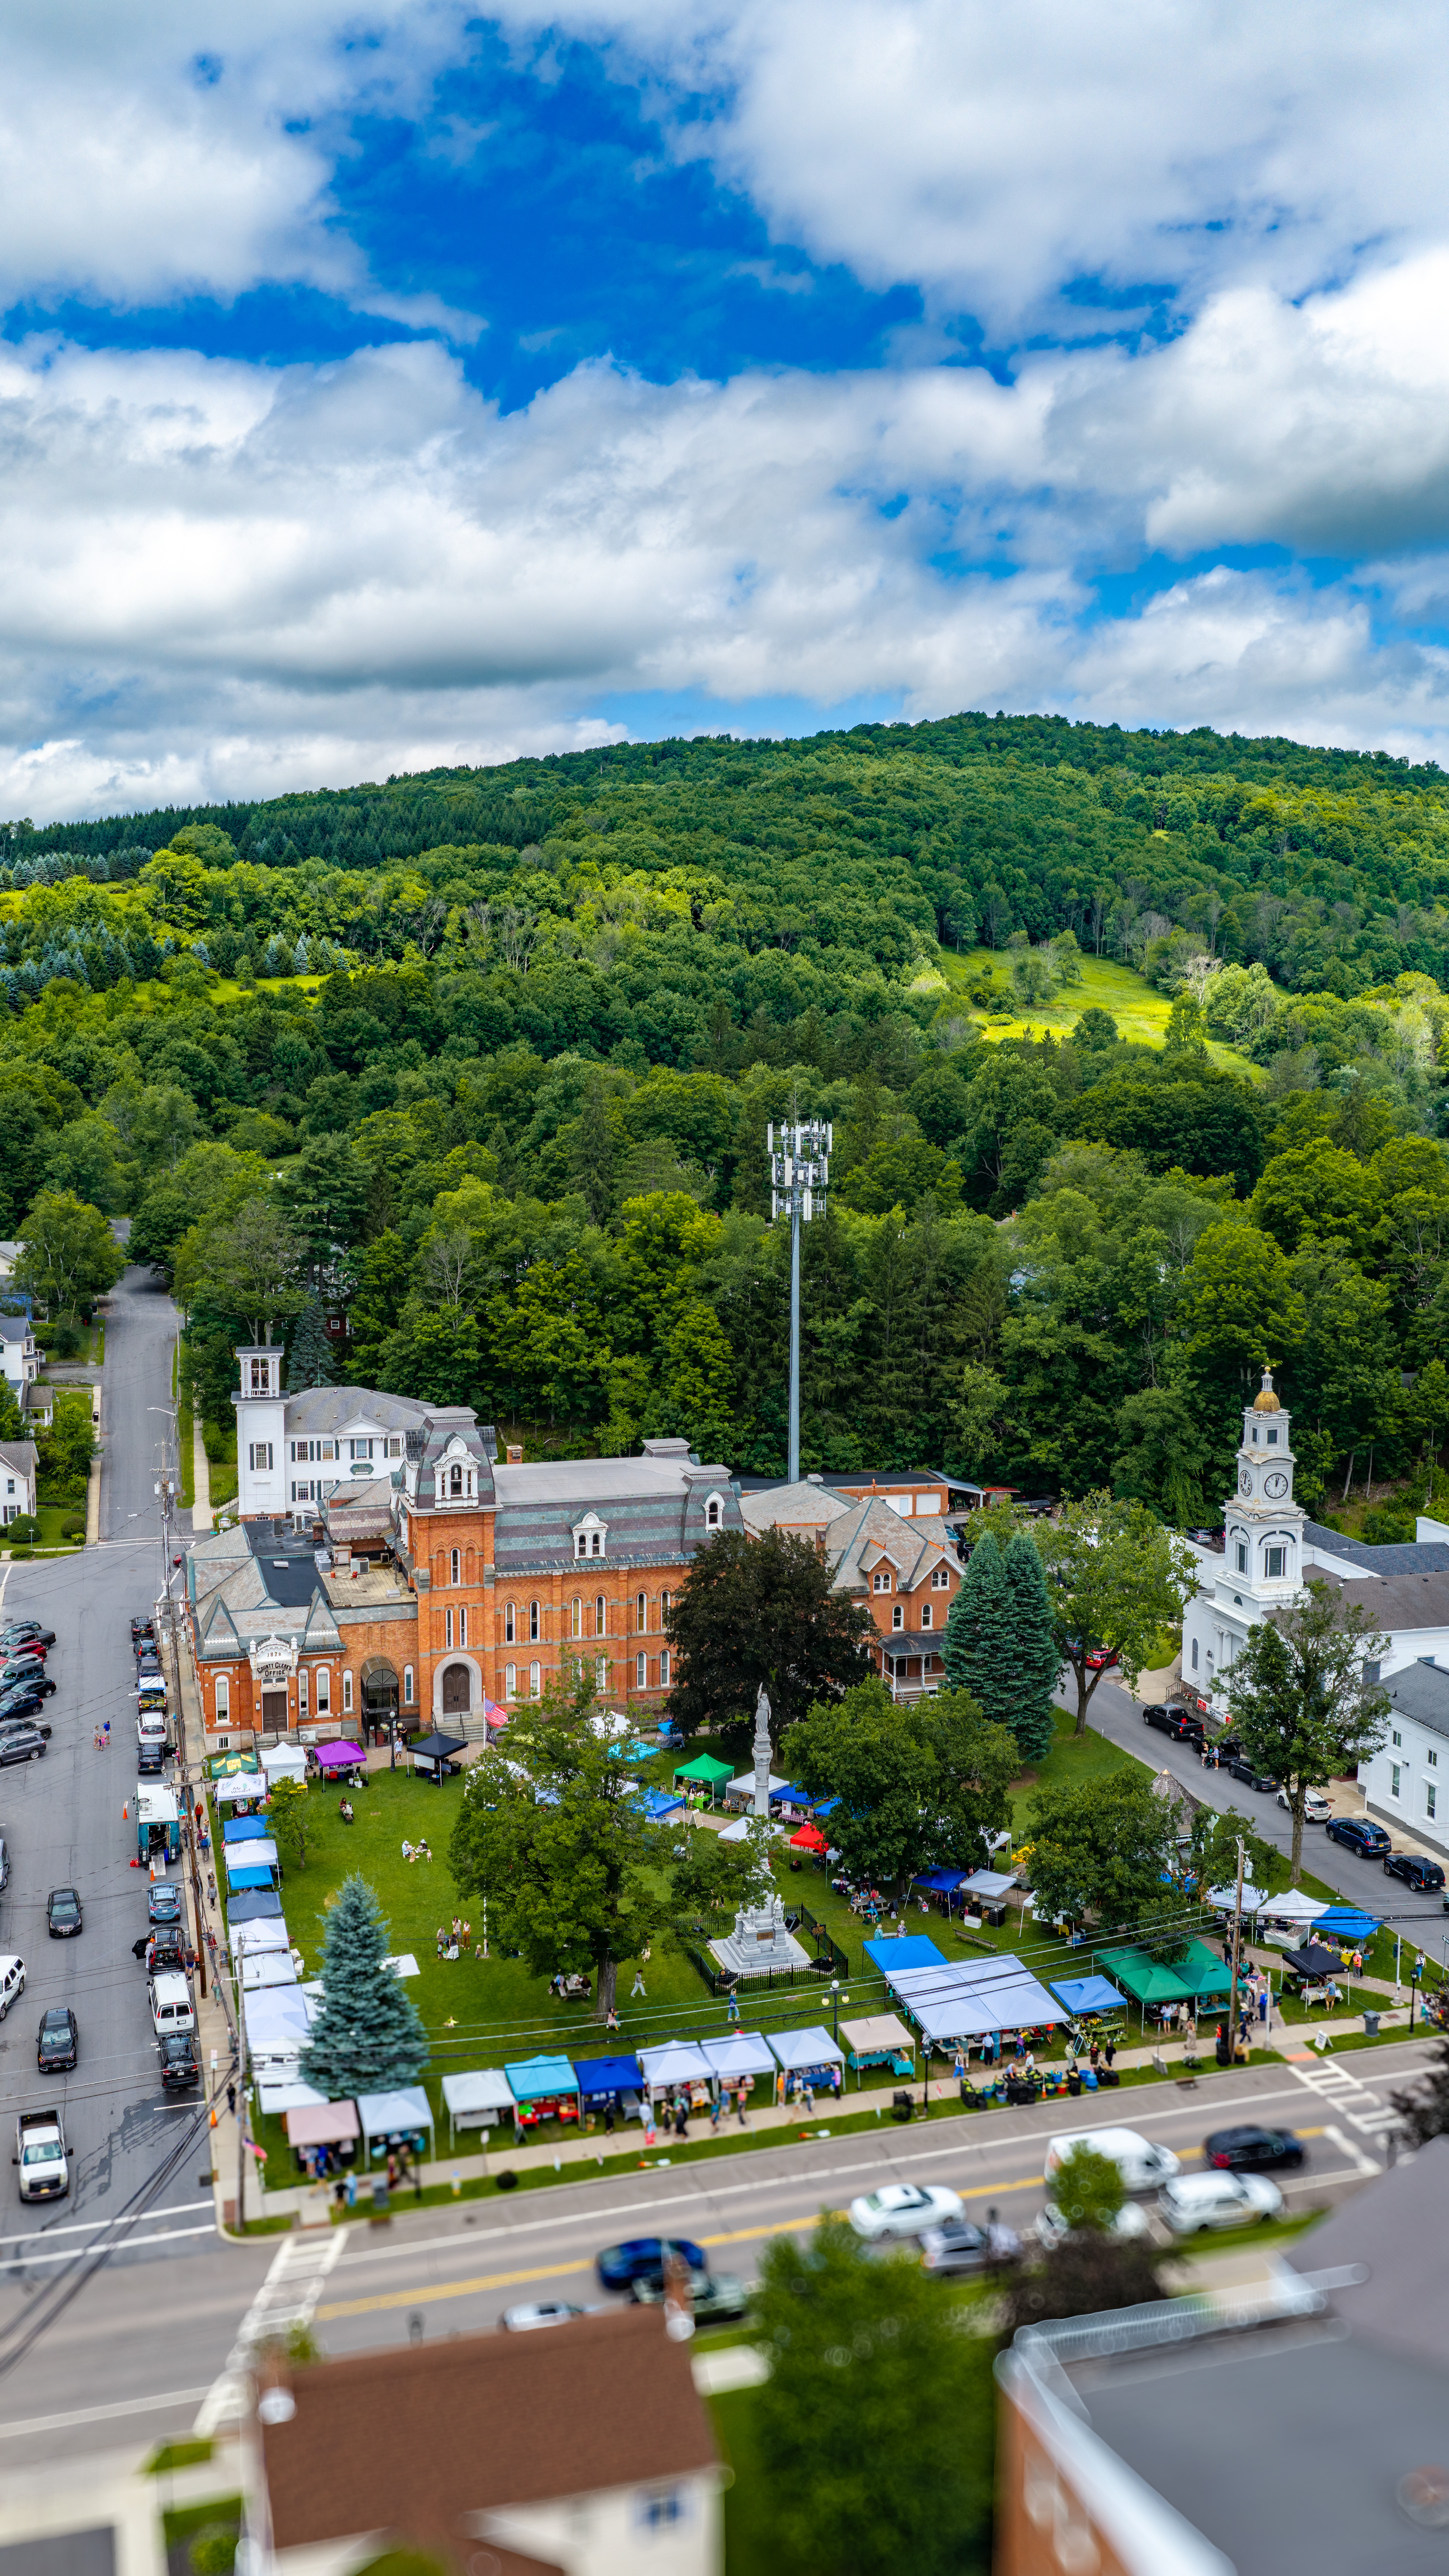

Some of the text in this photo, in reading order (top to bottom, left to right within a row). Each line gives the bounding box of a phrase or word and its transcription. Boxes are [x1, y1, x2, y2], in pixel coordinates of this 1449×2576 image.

[257, 1662, 292, 1673] COUNTY CLERK'S
[1209, 1706, 1223, 1718] Celebrating
